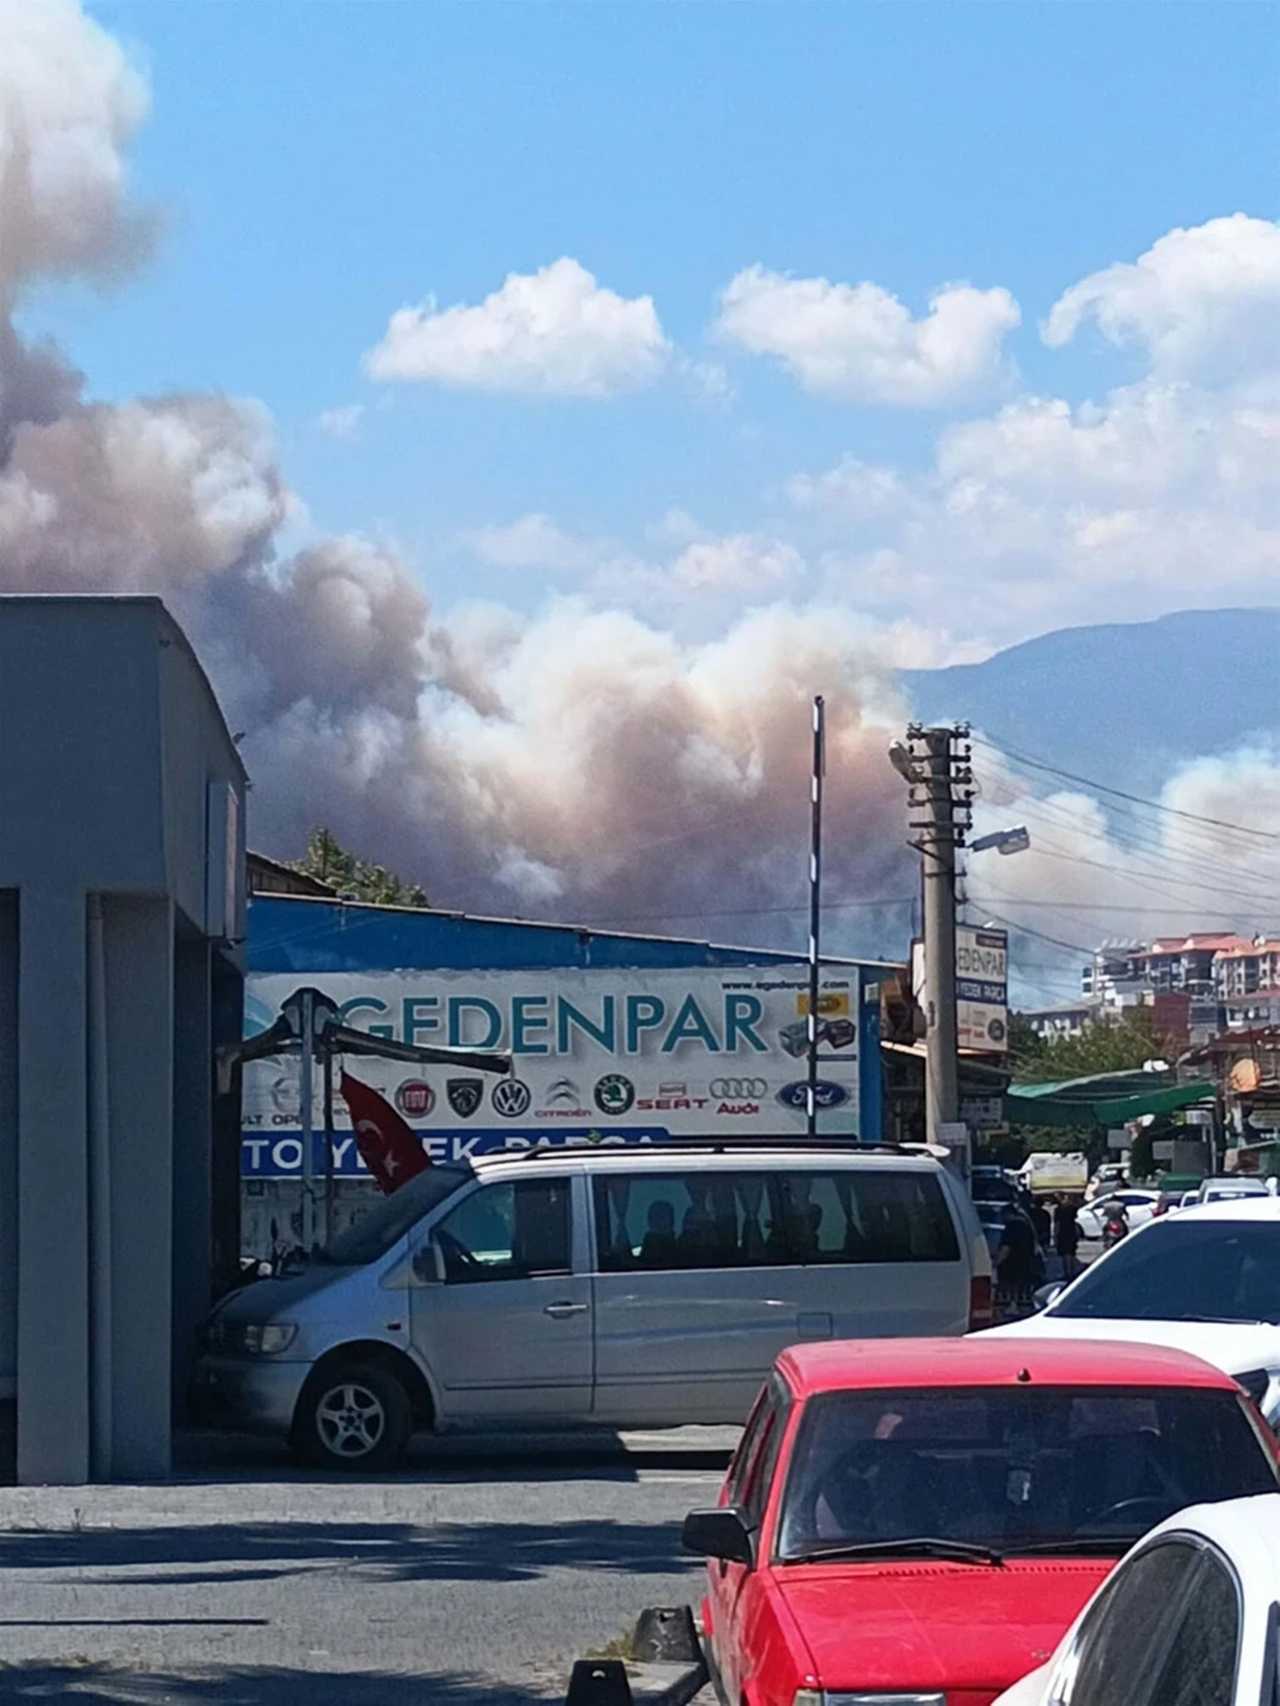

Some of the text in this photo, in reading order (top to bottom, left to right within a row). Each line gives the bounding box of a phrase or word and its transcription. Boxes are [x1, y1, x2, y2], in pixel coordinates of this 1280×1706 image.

[338, 993, 768, 1055] GEDENPAR
[637, 1099, 708, 1110] SEAT
[717, 1102, 759, 1115] Audi
